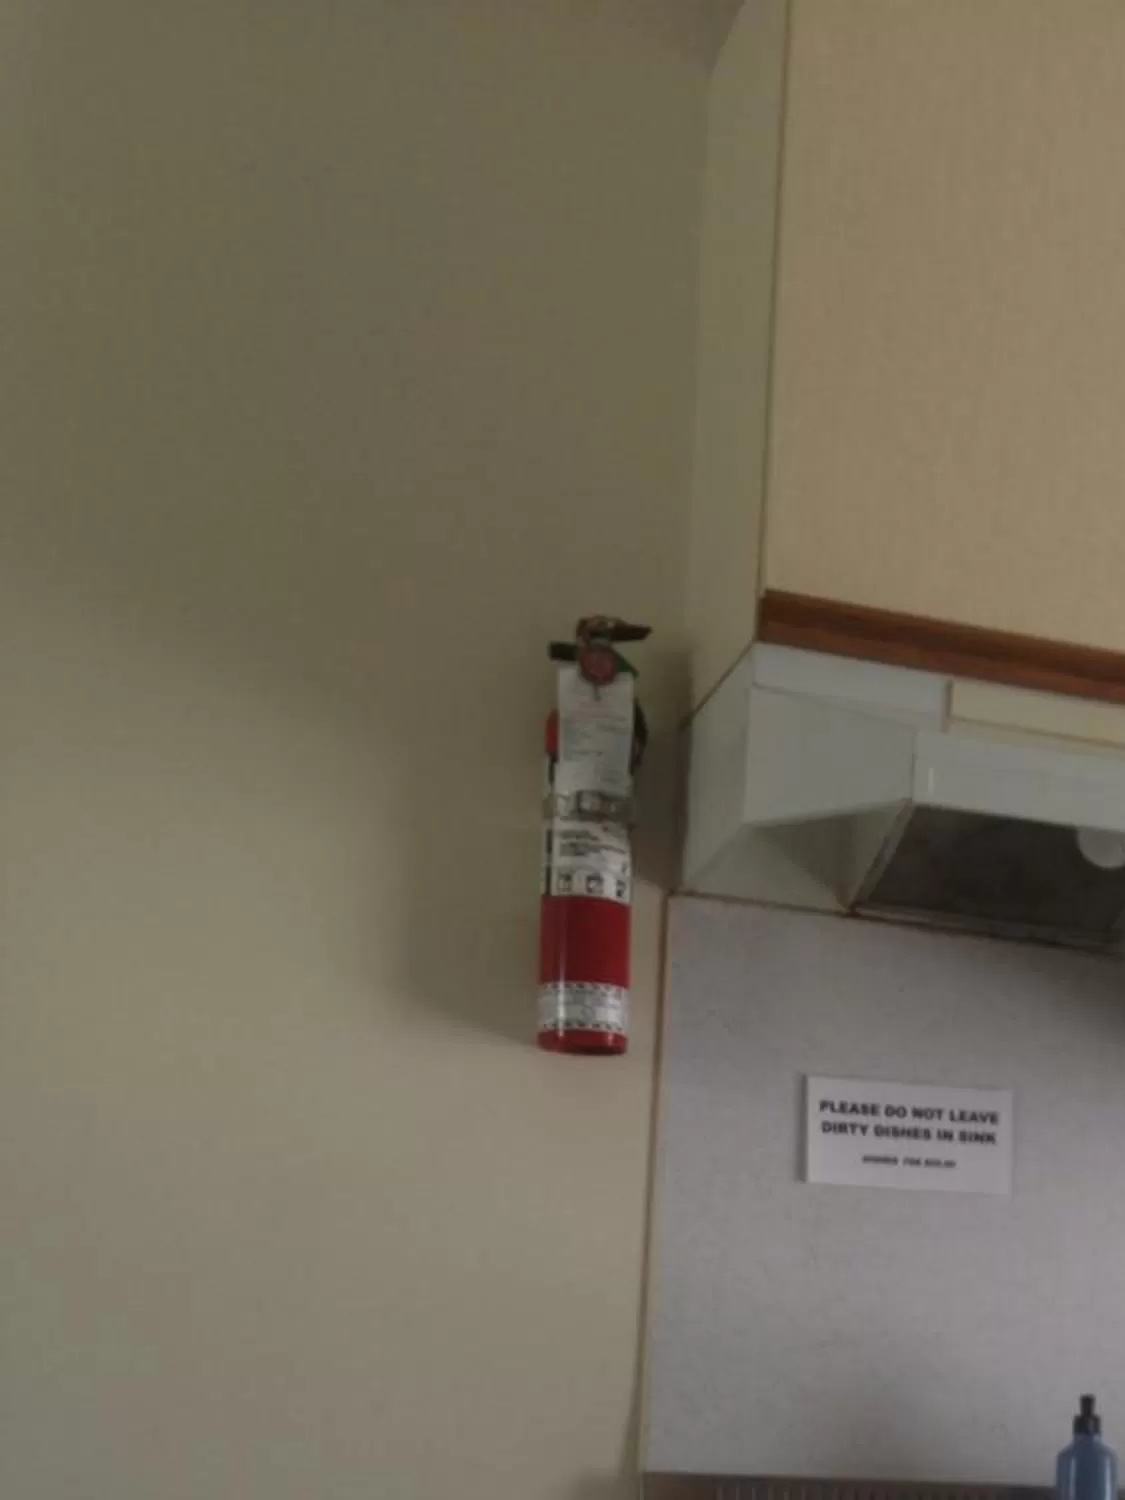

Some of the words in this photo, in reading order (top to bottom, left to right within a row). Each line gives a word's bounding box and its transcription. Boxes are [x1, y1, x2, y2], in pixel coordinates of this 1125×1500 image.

[819, 1100, 880, 1117] PLEASE
[884, 1104, 908, 1119] DO
[911, 1106, 944, 1121] NOT
[949, 1109, 999, 1125] LEAVE
[821, 1120, 870, 1137] DIRTY
[874, 1124, 932, 1141] DISHES
[937, 1128, 954, 1142] IN
[958, 1130, 997, 1145] SINK
